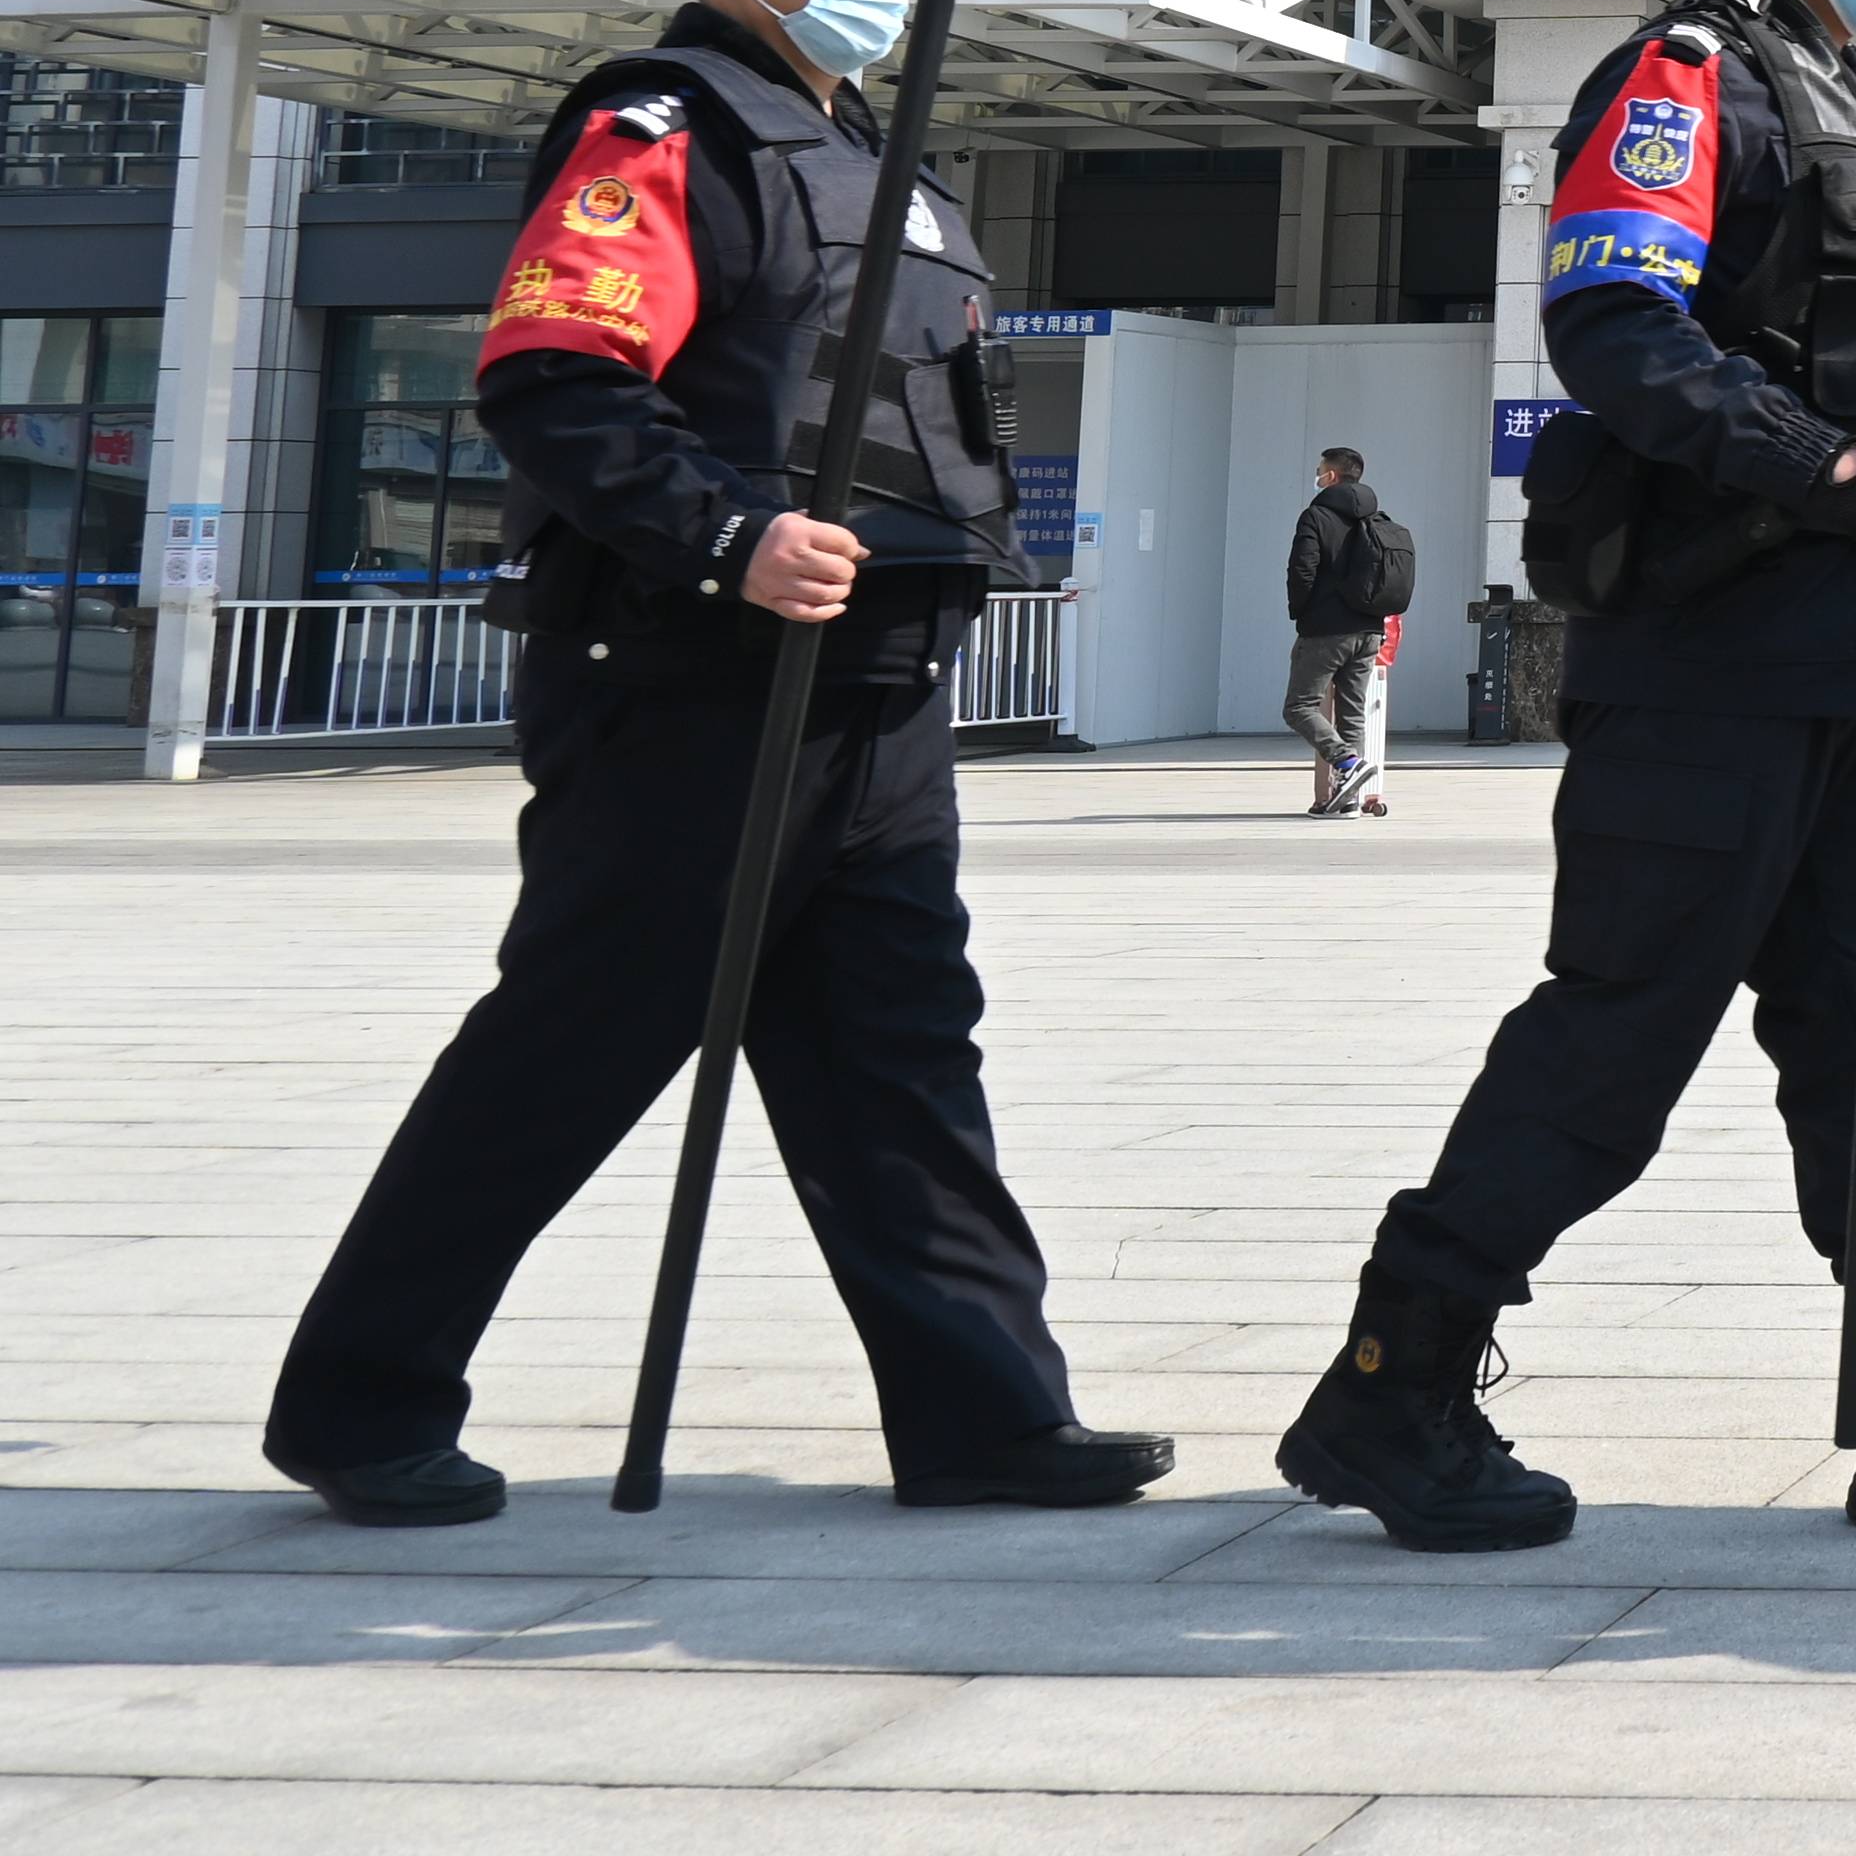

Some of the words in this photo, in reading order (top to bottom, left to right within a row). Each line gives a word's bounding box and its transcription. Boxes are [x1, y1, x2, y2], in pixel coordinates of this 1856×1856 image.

[505, 259, 643, 314] 执勤
[996, 315, 1095, 333] 旅客专用通道
